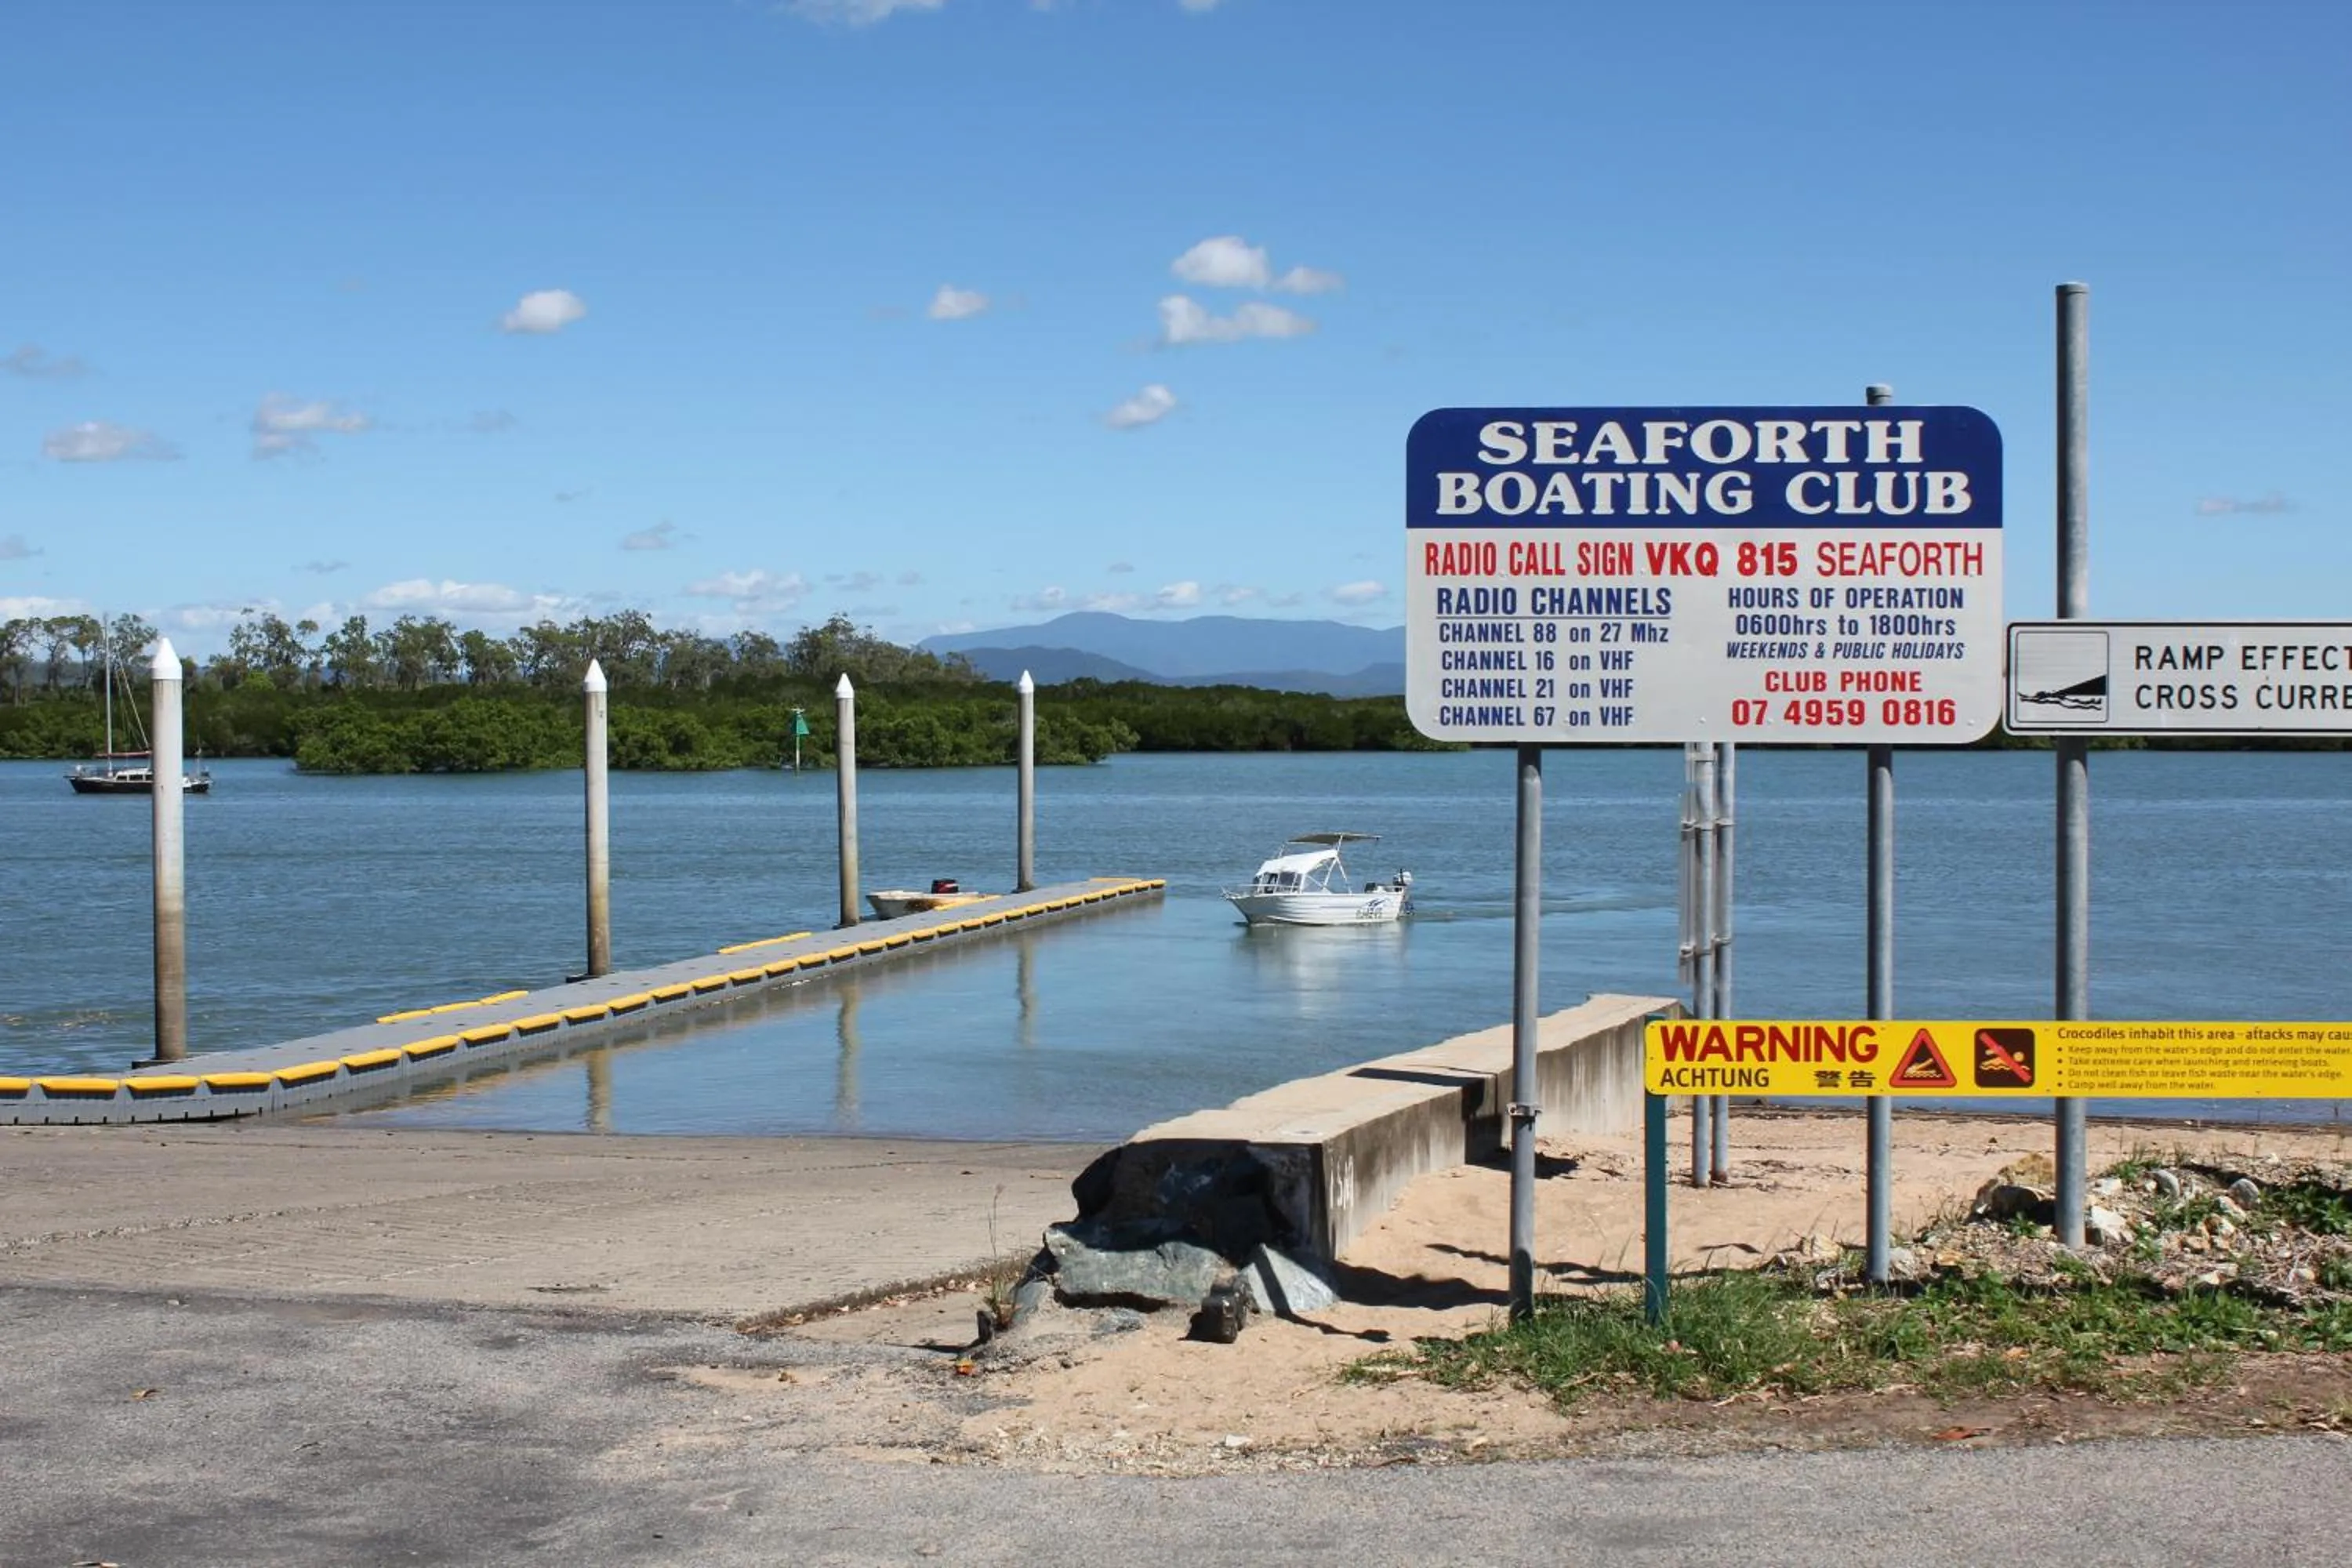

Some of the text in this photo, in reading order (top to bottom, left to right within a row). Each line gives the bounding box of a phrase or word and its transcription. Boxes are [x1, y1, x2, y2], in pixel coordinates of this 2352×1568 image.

[1478, 420, 1923, 464] SEAFORTH
[1436, 470, 1971, 515] BOATING CLUB
[1426, 542, 1982, 576] RADIO CALL SIGN VKQ 815 SEAFORTH
[1438, 587, 1671, 615] RADIO CHANNELS
[1729, 588, 1962, 608] HOURS OF OPERATION
[1439, 622, 1668, 643] CHANNEL 88 on 27 Mhz
[1736, 615, 1955, 635] 0600hrs to 1800hrs
[1443, 651, 1633, 670] CHANNEL 16 on VHF
[1727, 642, 1964, 659] WEEKENDS & PUBLIC HOLIDAYS
[2136, 646, 2223, 670] RAMP
[1443, 678, 1633, 698] CHANNEL 21 on VHF
[1766, 671, 1922, 691] CLUB PHONE
[2136, 684, 2238, 709] CROSS
[1440, 706, 1632, 726] CHANNEL 67 on VHF
[1733, 699, 1955, 725] 07 4959 0816
[1661, 1025, 1878, 1063] WARNING
[2058, 1027, 2125, 1039] Crocodiles
[2129, 1027, 2174, 1040] inhabit
[2179, 1028, 2204, 1040] this
[2207, 1031, 2234, 1040] area
[2245, 1026, 2293, 1040] attacks
[2297, 1031, 2325, 1043] may
[2068, 1046, 2092, 1055] Keep
[2095, 1047, 2118, 1055] away
[2121, 1045, 2142, 1054] from
[2145, 1045, 2161, 1054] the
[2199, 1045, 2223, 1056] edge
[2226, 1045, 2243, 1054] and
[2245, 1045, 2257, 1054] do
[2260, 1046, 2275, 1054] not
[2306, 1046, 2321, 1054] the
[2069, 1056, 2090, 1065] Take
[2155, 1057, 2181, 1065] when
[1661, 1068, 1769, 1087] ACHTUNG
[2068, 1068, 2082, 1076] Do
[2102, 1068, 2126, 1078] clean
[2129, 1068, 2146, 1078] fish
[2161, 1069, 2187, 1078] leave
[2188, 1069, 2207, 1078] fish
[2209, 1069, 2237, 1078] waste
[2263, 1069, 2278, 1078] the
[2098, 1080, 2117, 1089] well
[2120, 1082, 2143, 1091] away
[2146, 1080, 2167, 1089] from
